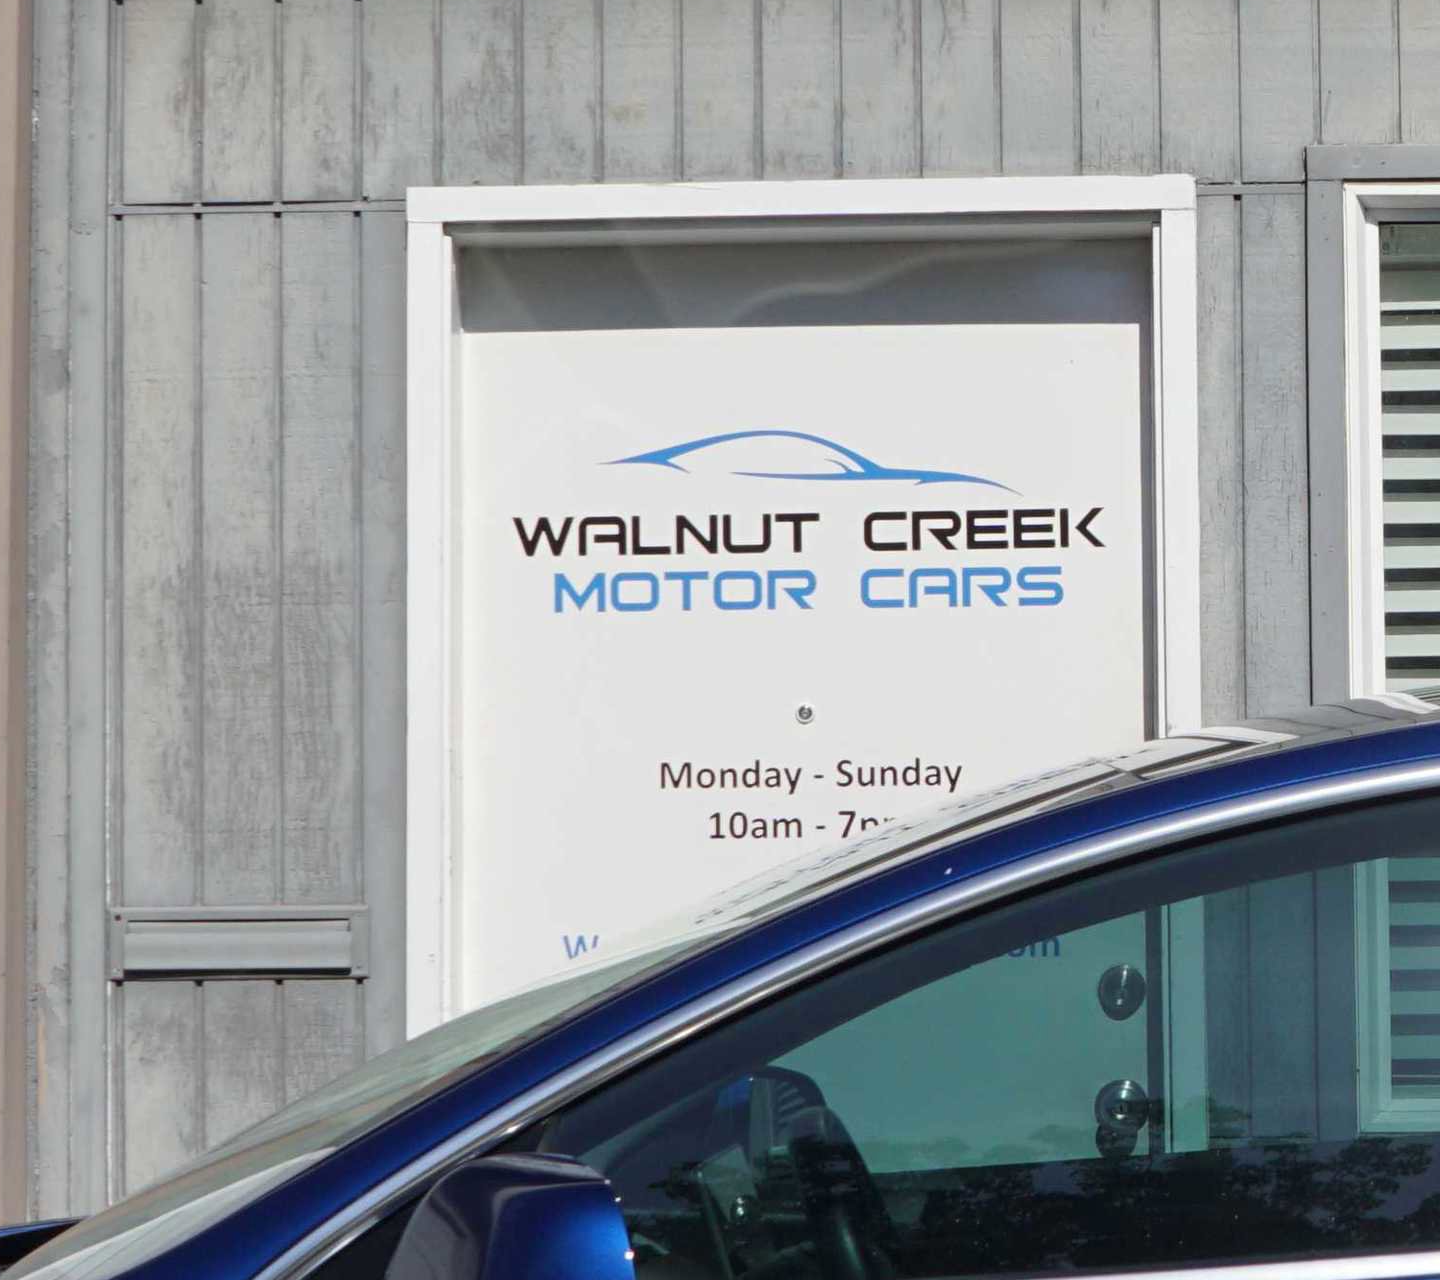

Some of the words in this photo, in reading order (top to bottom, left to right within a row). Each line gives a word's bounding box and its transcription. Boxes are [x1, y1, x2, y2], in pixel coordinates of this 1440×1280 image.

[513, 512, 820, 557] WALNUT
[863, 507, 1106, 552] CREEK
[553, 569, 817, 613] MOTOR
[860, 564, 1064, 609] CARS
[660, 760, 802, 795] Monday
[836, 758, 962, 793] Sunday
[709, 811, 803, 839] 10am
